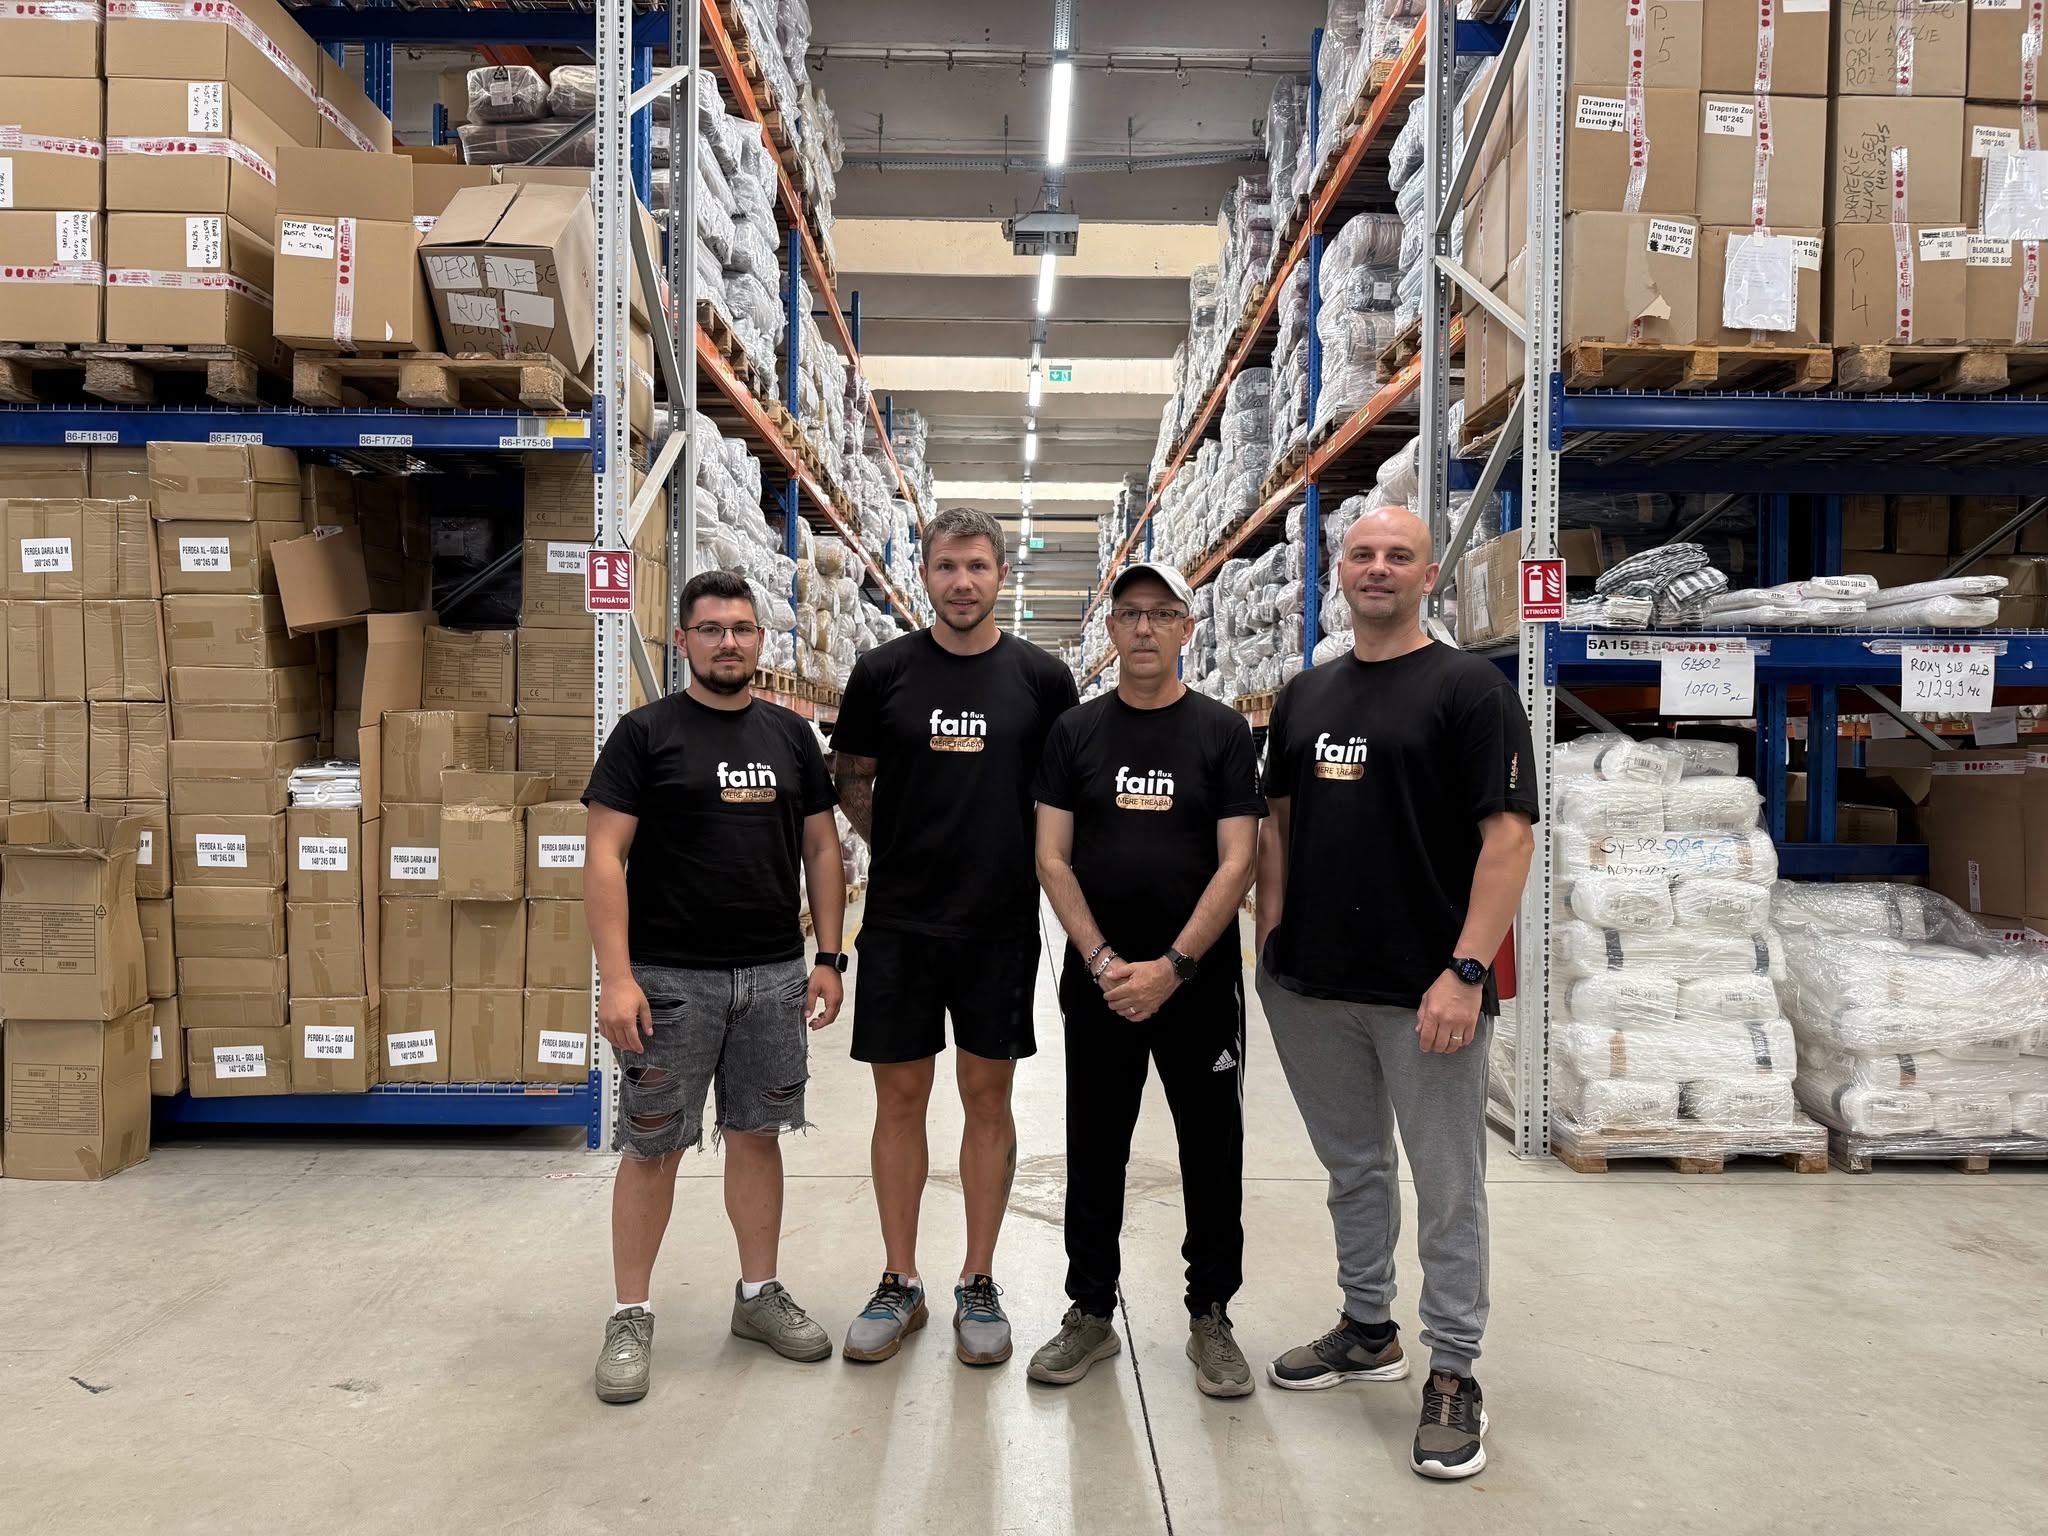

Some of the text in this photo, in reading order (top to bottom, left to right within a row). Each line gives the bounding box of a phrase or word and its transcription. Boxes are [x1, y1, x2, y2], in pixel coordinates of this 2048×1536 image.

[1582, 98, 1624, 109] Draperie
[1581, 107, 1623, 118] Glamour
[1709, 104, 1739, 113] Draperie
[1579, 117, 1608, 125] Bordo
[1975, 128, 1996, 137] Perdea
[1652, 222, 1693, 235] Perdea Voal
[1651, 232, 1662, 240] Alb
[66, 432, 118, 441] 86-F181-06
[210, 434, 262, 443] 86-F179-06
[360, 436, 411, 445] 86-F177-06
[501, 438, 552, 447] 86-F175-06
[550, 550, 565, 558] PERDEA
[1968, 663, 1990, 676] ALB
[929, 709, 987, 736] fain
[1314, 732, 1367, 763] fain
[716, 761, 777, 788] fain
[1115, 765, 1175, 795] fain
[1118, 797, 1138, 805] MERE
[199, 842, 216, 851] PERDEA
[237, 843, 245, 851] ALB
[302, 845, 318, 854] PERDEA
[338, 846, 347, 854] ALB
[541, 843, 558, 851] PERDEA
[572, 843, 580, 851] ALB
[307, 1034, 324, 1042] PERDEA
[345, 1034, 353, 1043] ALB
[391, 1041, 406, 1050] PERDEA
[420, 1039, 428, 1047] ALB
[217, 1054, 235, 1063] PERDEA
[255, 1053, 264, 1061] ALB
[1212, 1060, 1237, 1072] adidas
